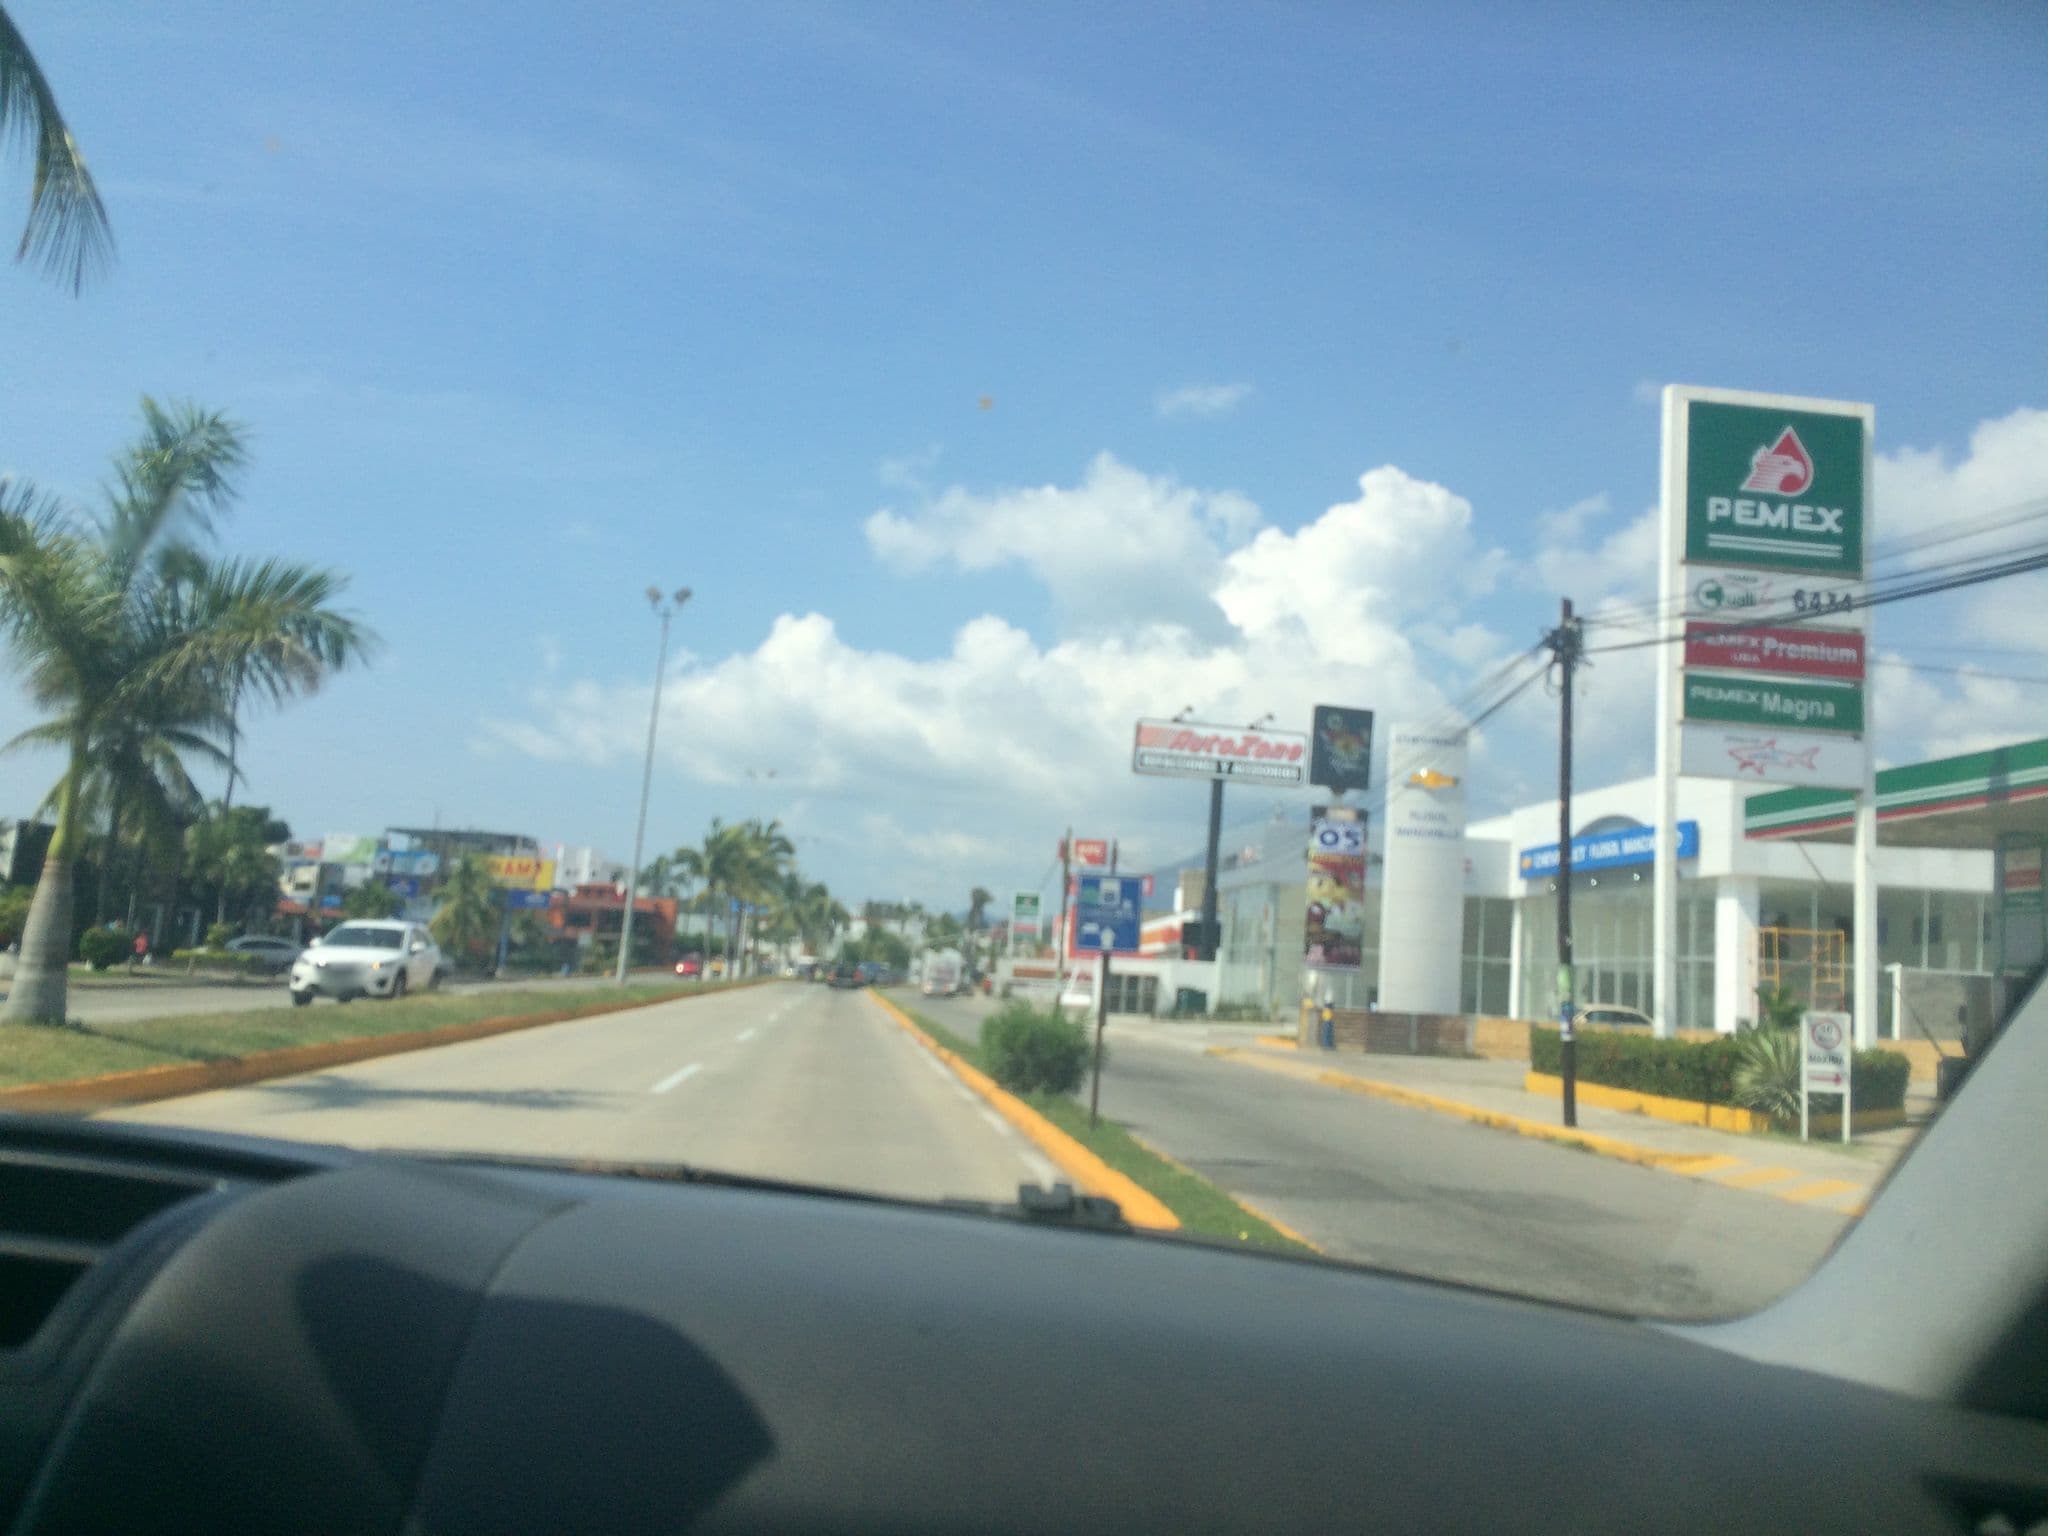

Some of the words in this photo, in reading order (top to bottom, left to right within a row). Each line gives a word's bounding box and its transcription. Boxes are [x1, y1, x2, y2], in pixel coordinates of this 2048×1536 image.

[1706, 497, 1844, 533] PEMEX
[1763, 636, 1858, 663] Premium
[1690, 685, 1760, 704] PEMEX
[1762, 692, 1836, 721] Magna
